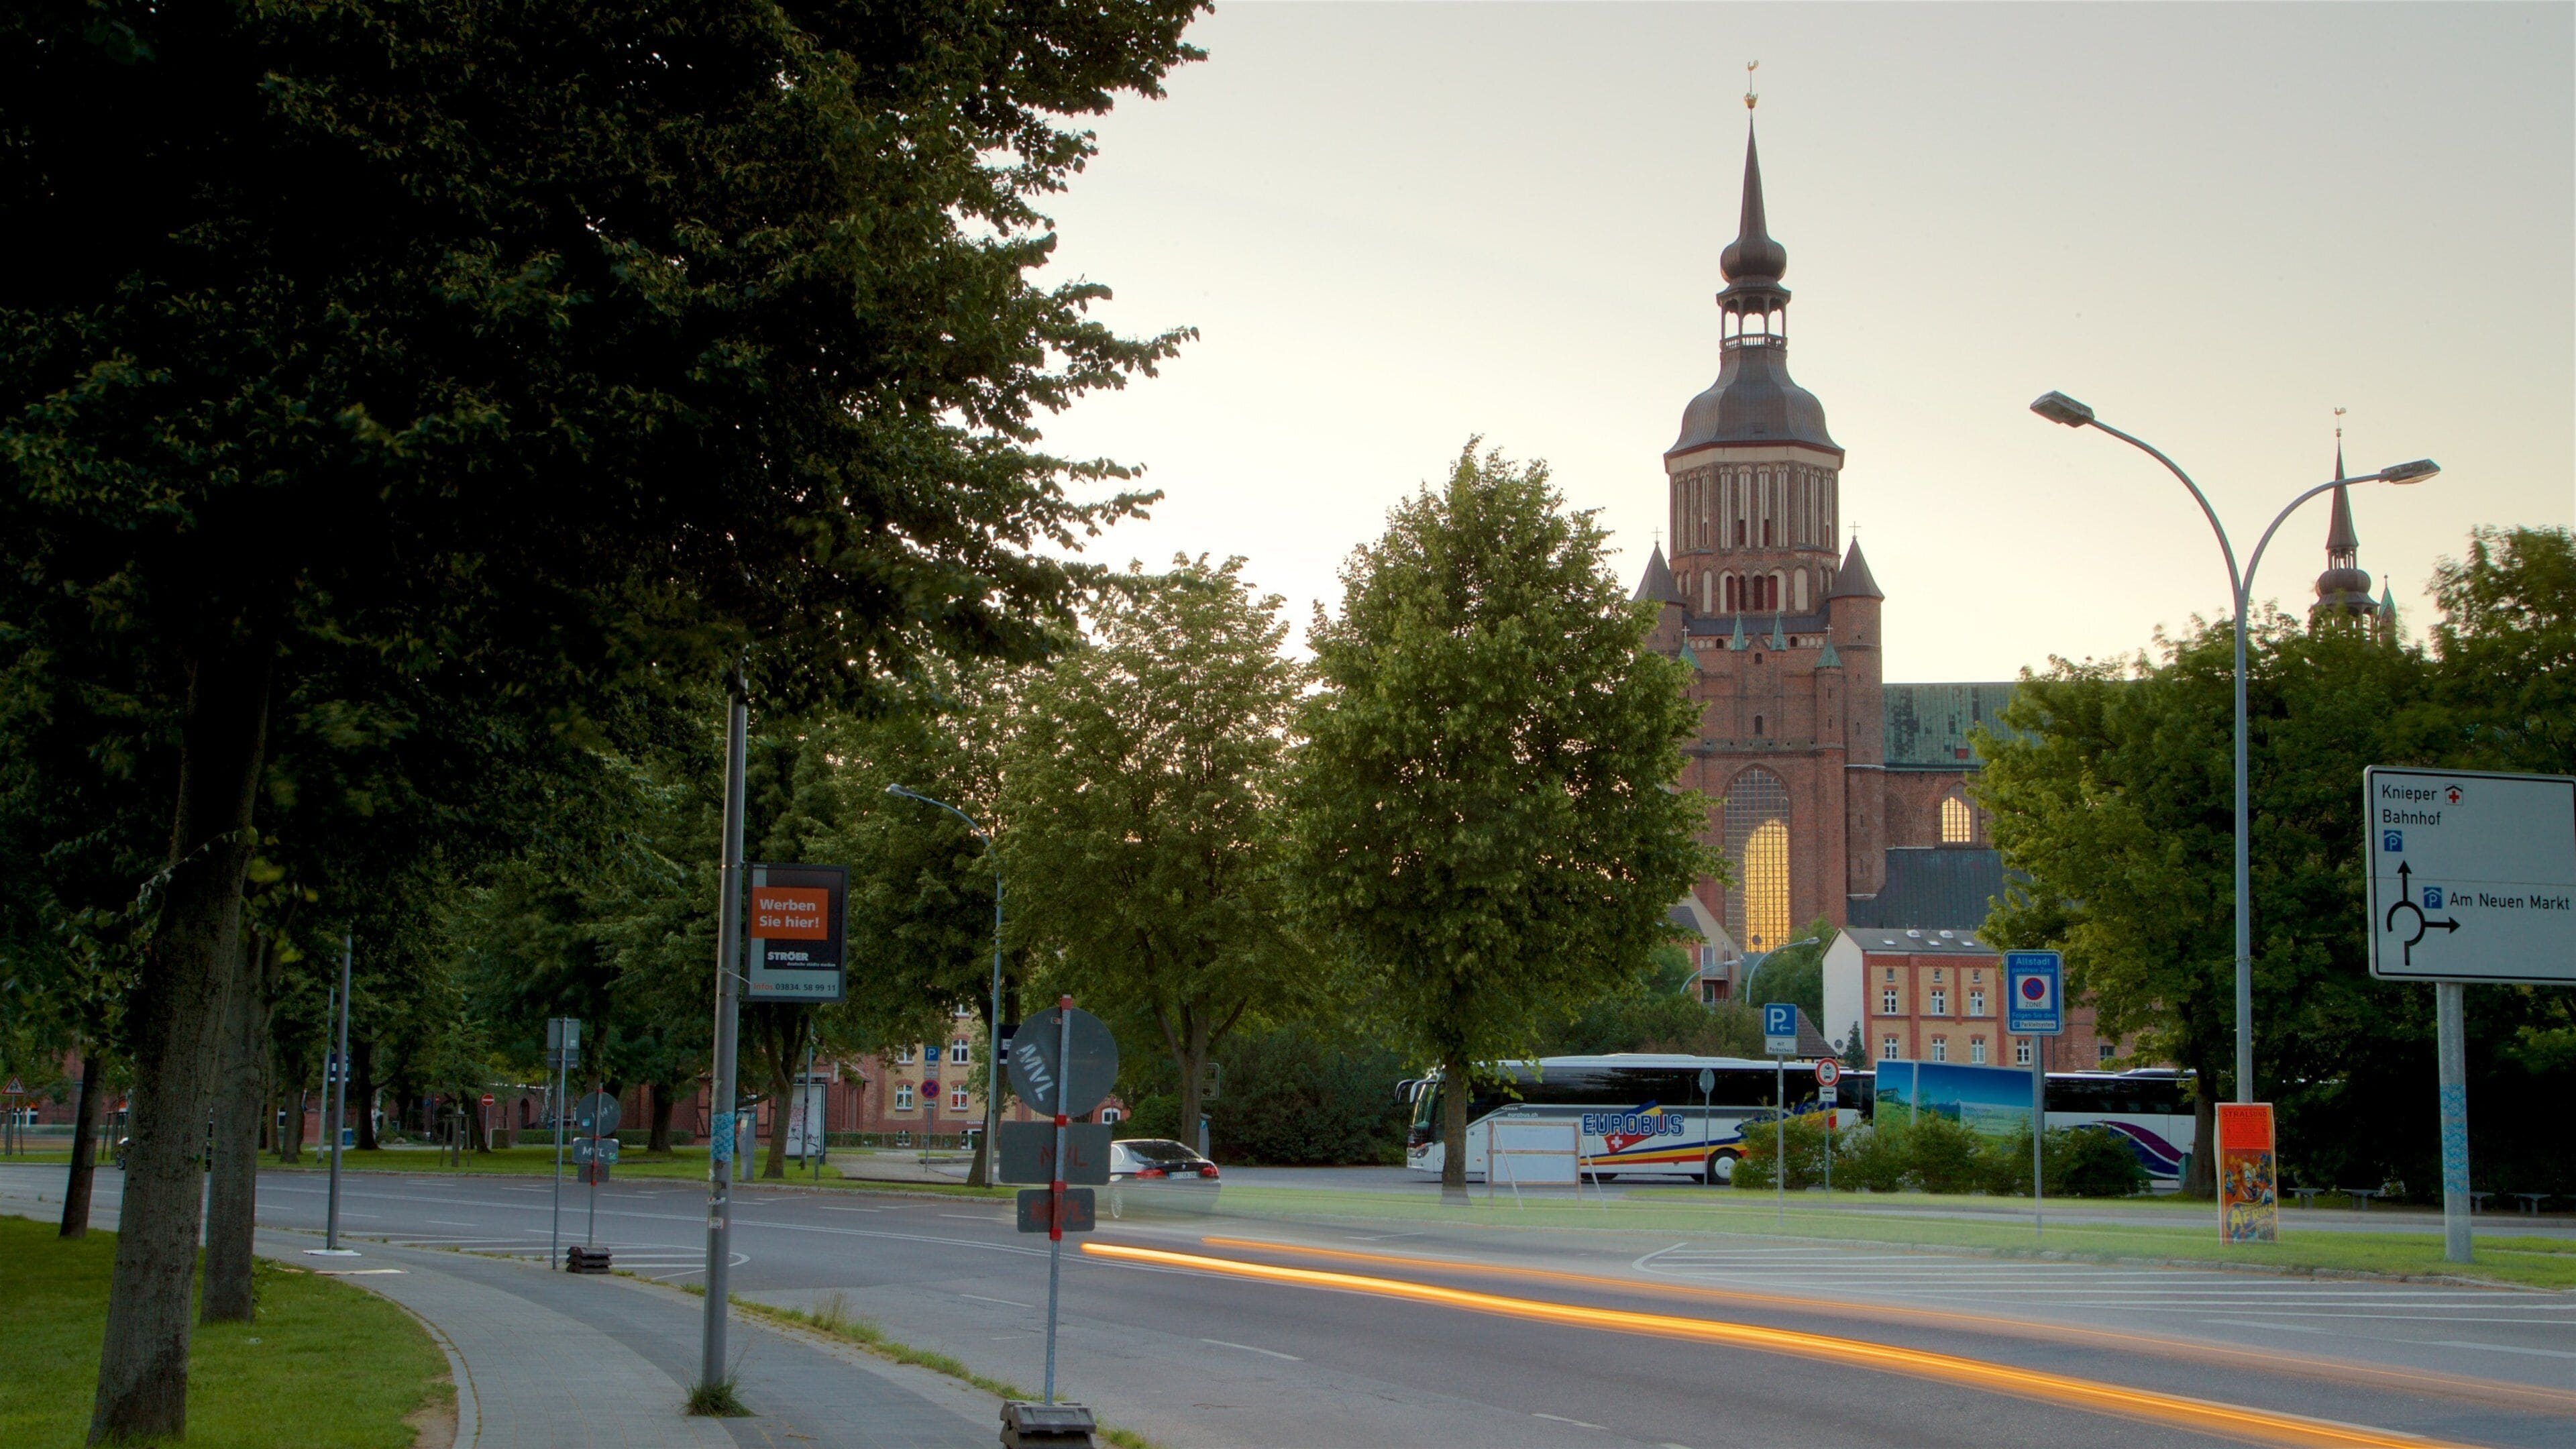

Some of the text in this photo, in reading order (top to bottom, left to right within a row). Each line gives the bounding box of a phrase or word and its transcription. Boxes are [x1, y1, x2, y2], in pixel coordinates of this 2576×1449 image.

[2381, 784, 2437, 803] Knieper
[2383, 810, 2441, 826] Bahnhof
[2389, 837, 2398, 850] P
[759, 899, 816, 911] Werben
[2428, 892, 2570, 910] P Am Neuen Markt
[759, 915, 819, 928] Sie hier!
[767, 952, 808, 961] STRÖER
[2016, 957, 2051, 965] Altstadt
[1770, 1008, 1786, 1032] P
[928, 1049, 936, 1059] P
[1015, 1042, 1055, 1102] MVL
[1582, 1113, 1684, 1136] EUROBUS
